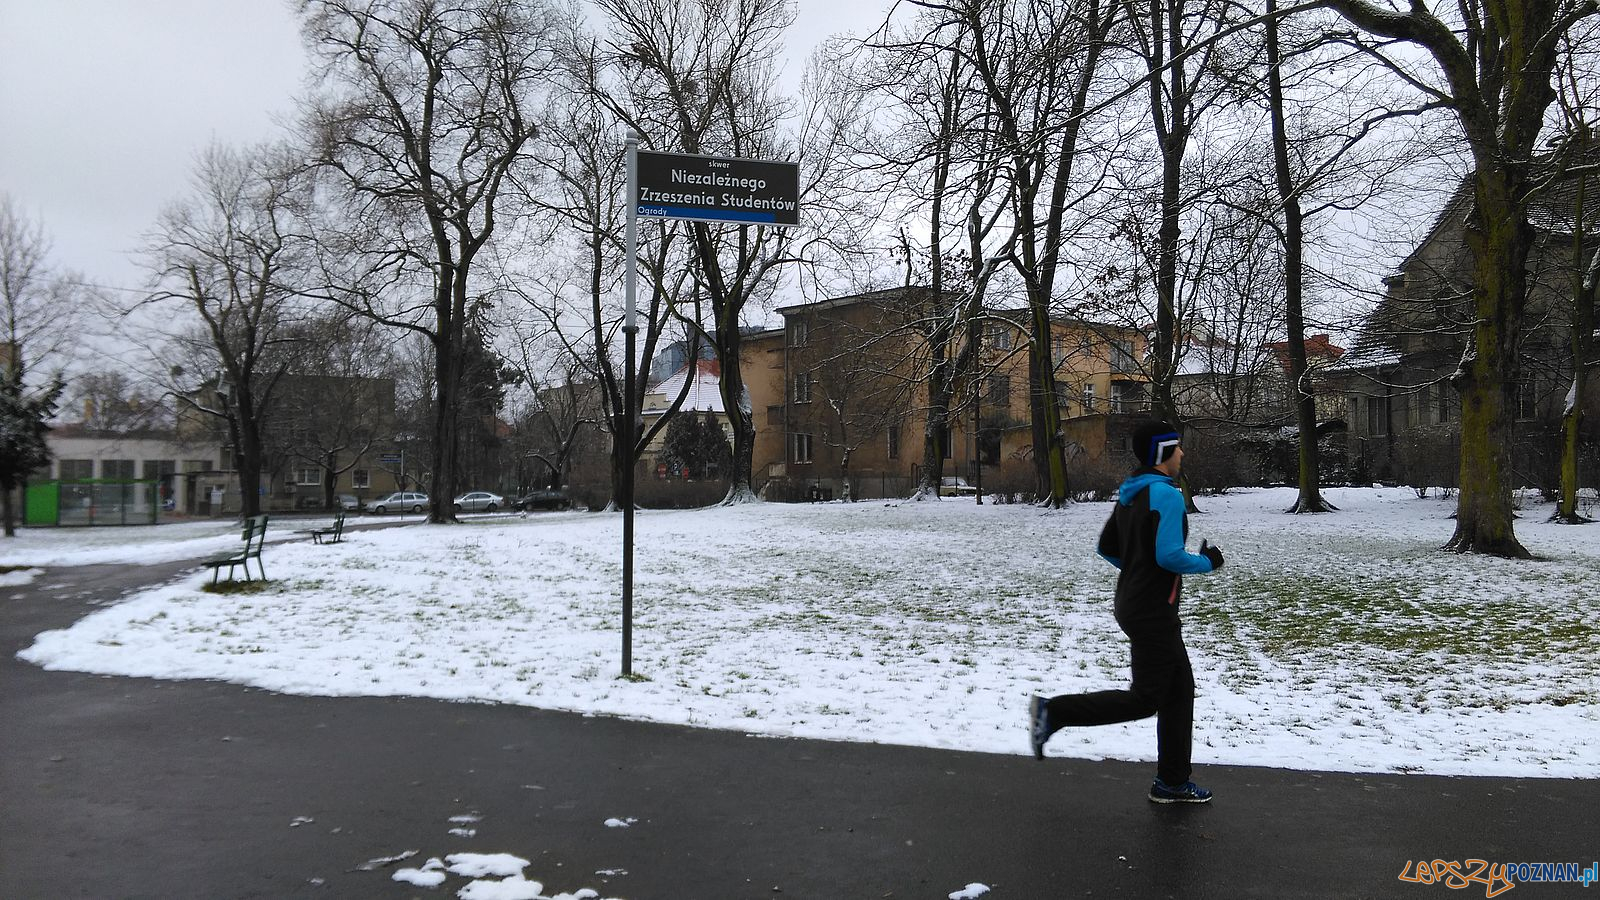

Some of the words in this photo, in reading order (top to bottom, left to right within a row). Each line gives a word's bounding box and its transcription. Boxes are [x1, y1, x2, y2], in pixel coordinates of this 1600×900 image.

[708, 160, 730, 169] skwer
[671, 169, 766, 192] Niezależnego
[640, 187, 715, 206] Zrzeszenia
[721, 193, 795, 211] Studentów
[637, 206, 667, 216] Ogrody
